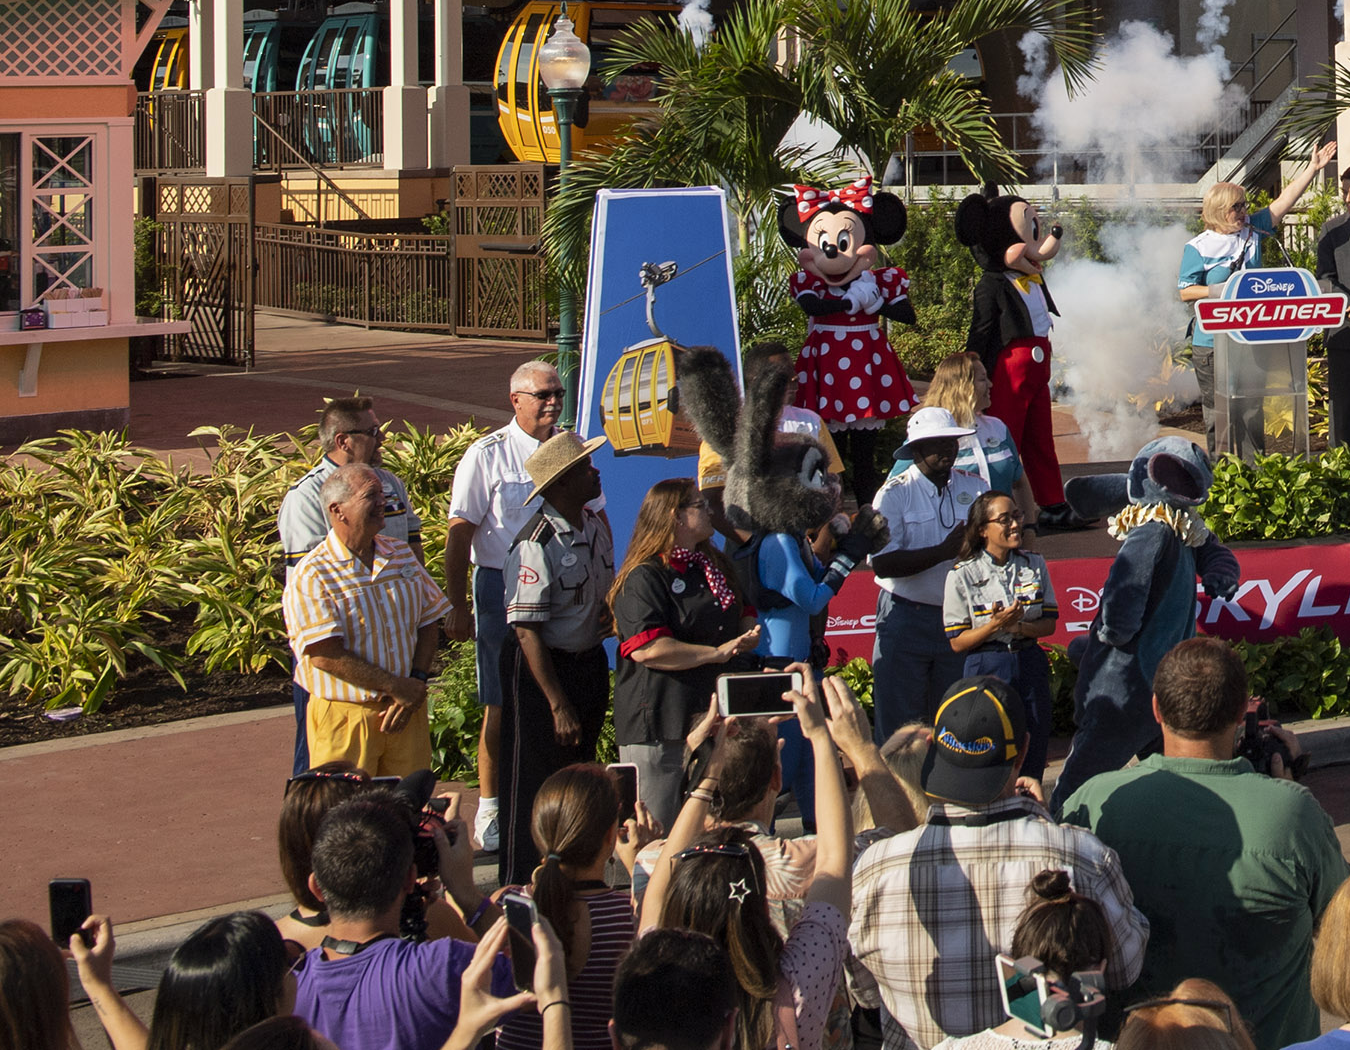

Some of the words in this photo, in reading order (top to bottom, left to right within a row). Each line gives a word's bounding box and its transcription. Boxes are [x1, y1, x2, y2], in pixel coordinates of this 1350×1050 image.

[542, 126, 556, 134] 050
[1248, 277, 1295, 296] Disney
[1208, 303, 1340, 325] SKYLINER
